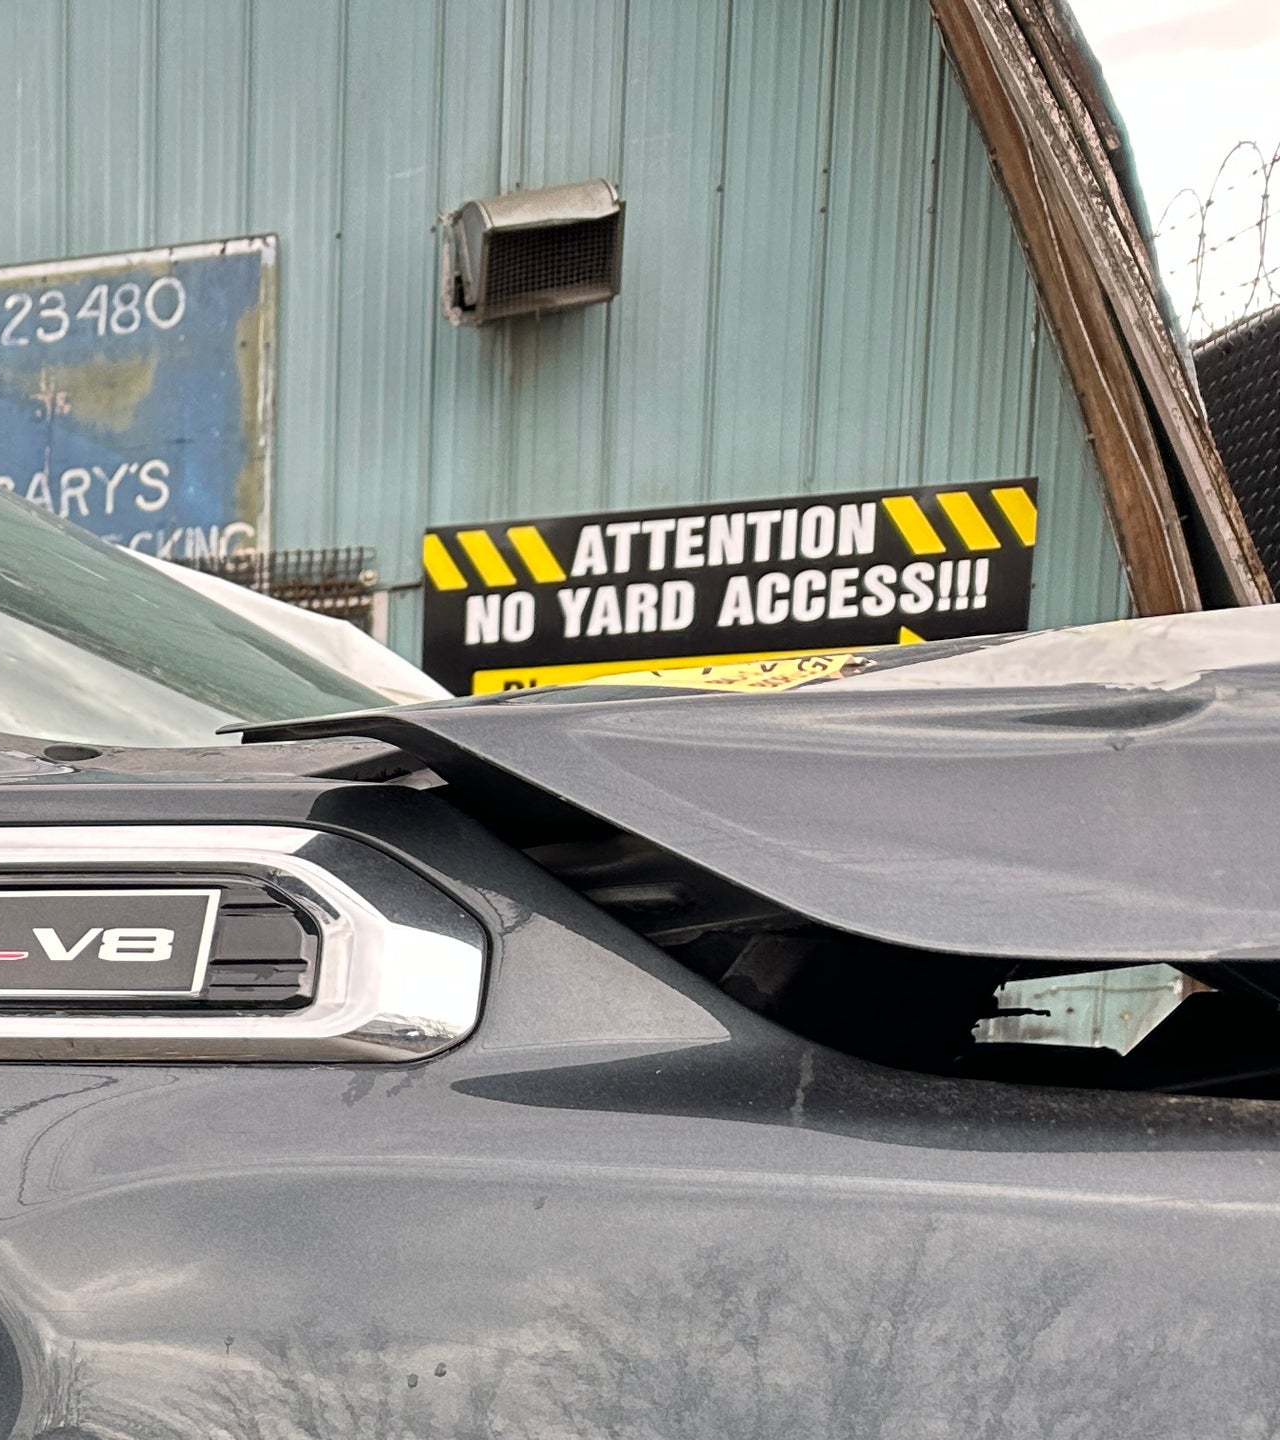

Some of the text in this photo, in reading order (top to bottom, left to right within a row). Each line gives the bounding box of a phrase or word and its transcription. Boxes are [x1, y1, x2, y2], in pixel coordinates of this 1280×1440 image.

[0, 276, 187, 347] 23480
[570, 502, 877, 577] ATTENTION
[464, 557, 990, 646] NO YARD ACCESS!!!
